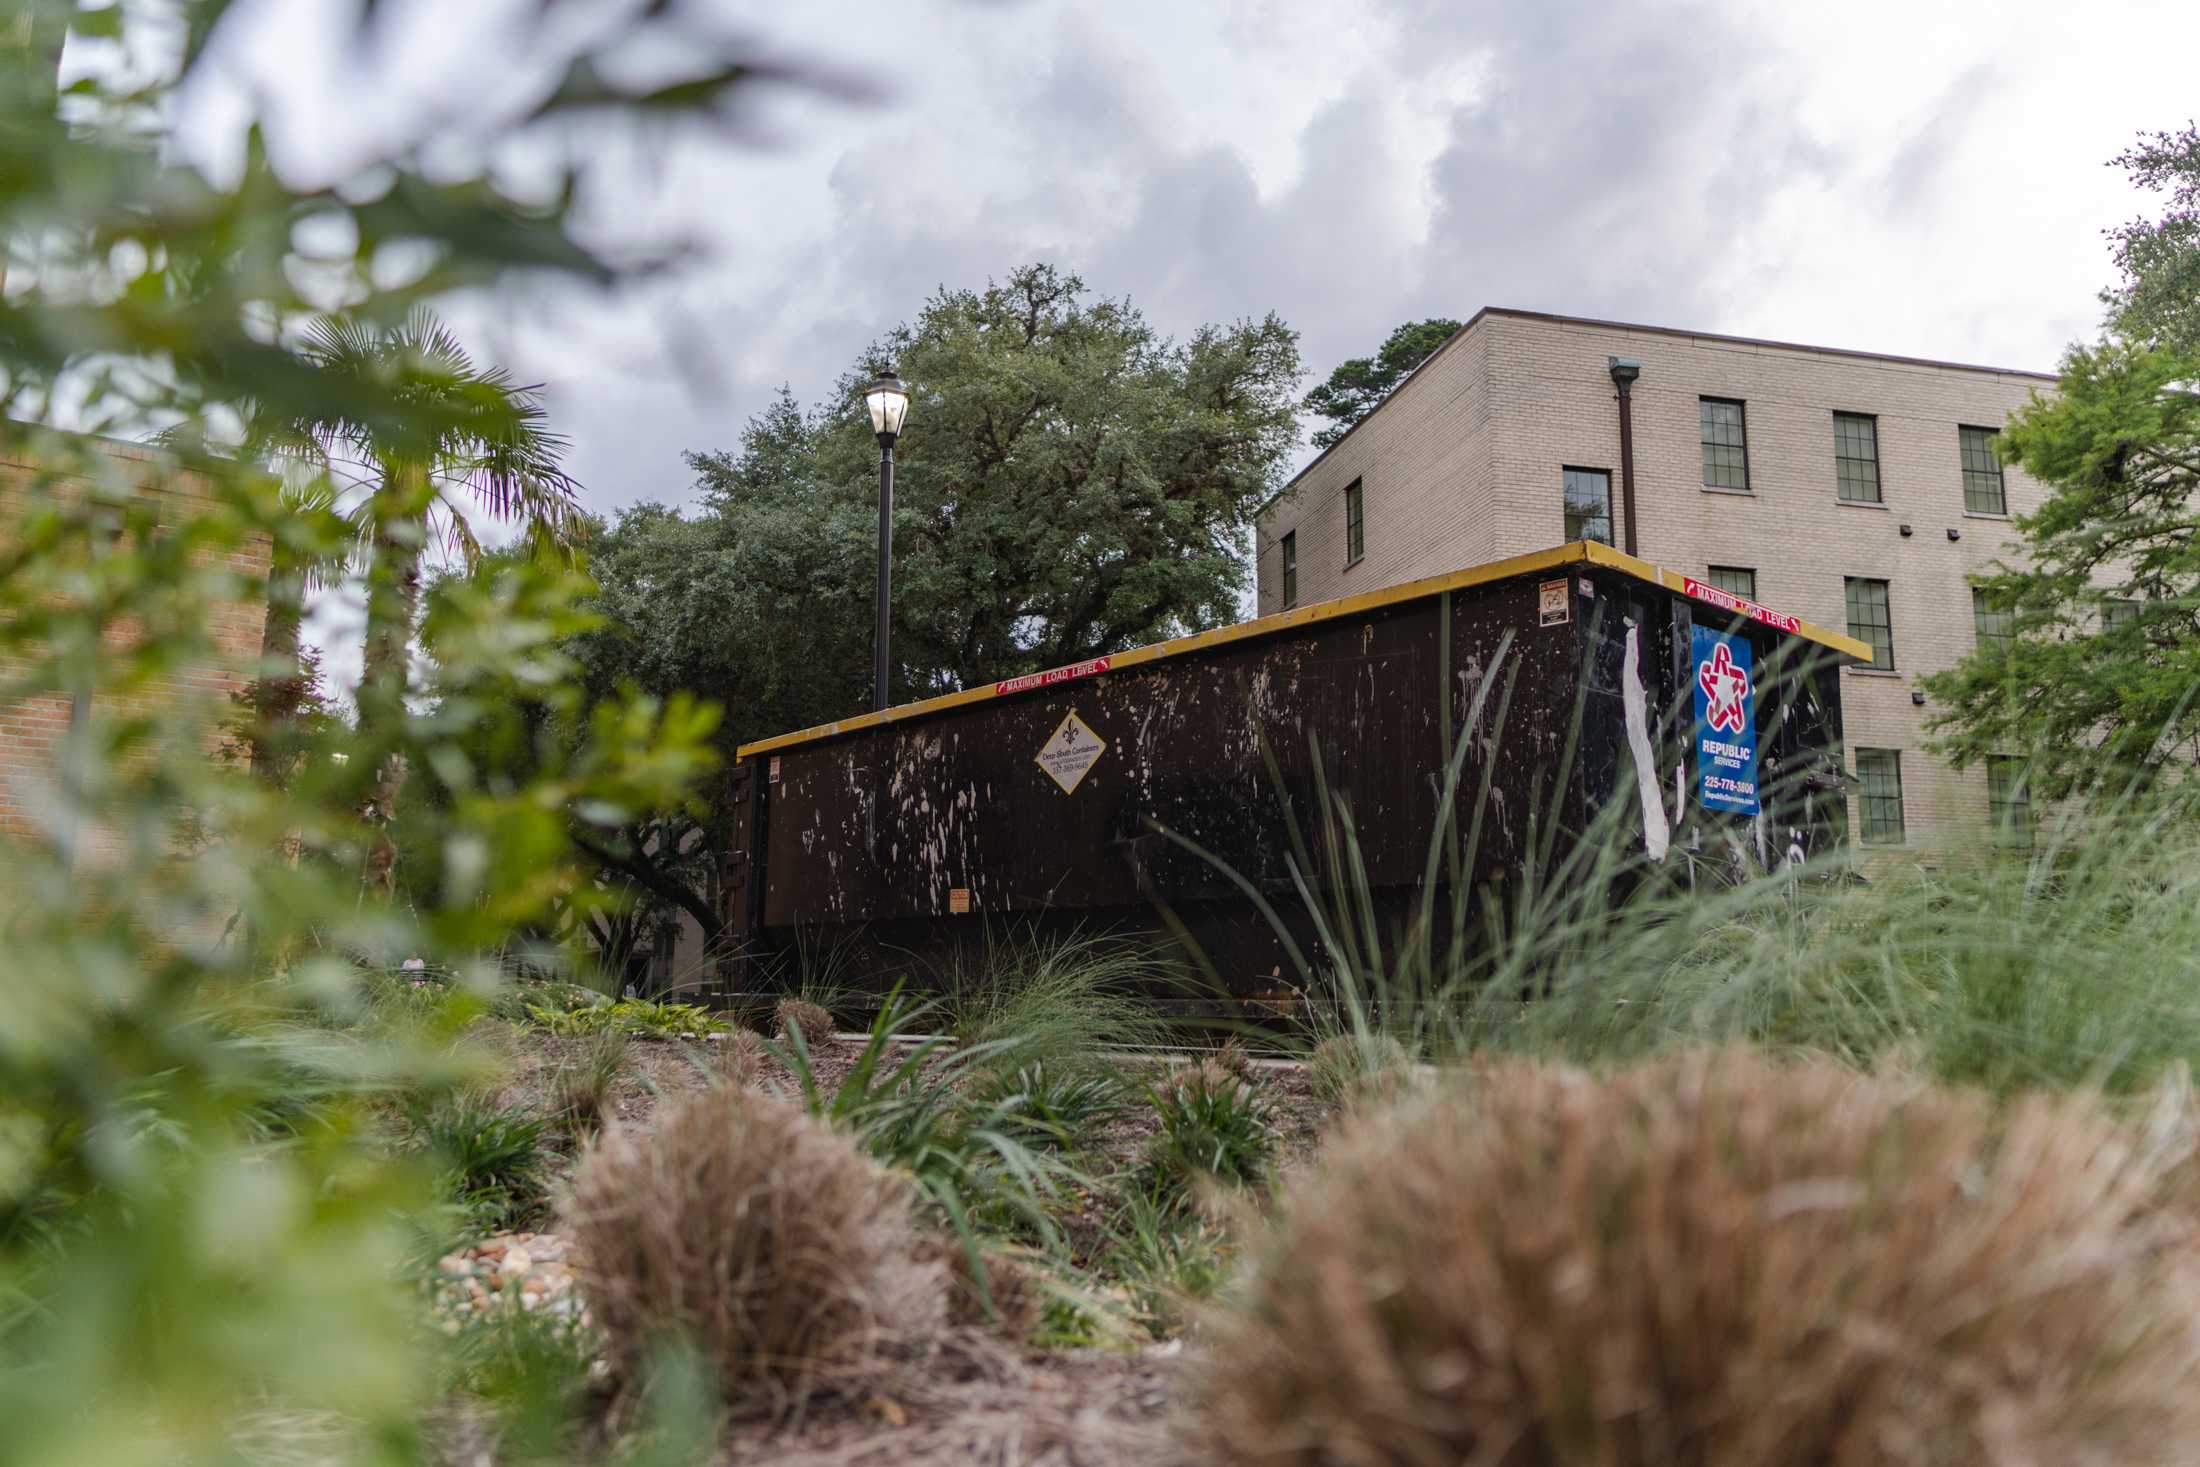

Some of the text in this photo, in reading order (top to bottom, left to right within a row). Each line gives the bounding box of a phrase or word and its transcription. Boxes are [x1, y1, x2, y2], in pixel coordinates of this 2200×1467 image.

[1696, 586, 1737, 609] MAXIMUM
[1766, 610, 1792, 631] LEVEL
[1006, 663, 1098, 692] MAXIMUM LOAD LEVEL
[1702, 739, 1750, 760] REPUBLIC
[1714, 755, 1741, 769] SERVICES
